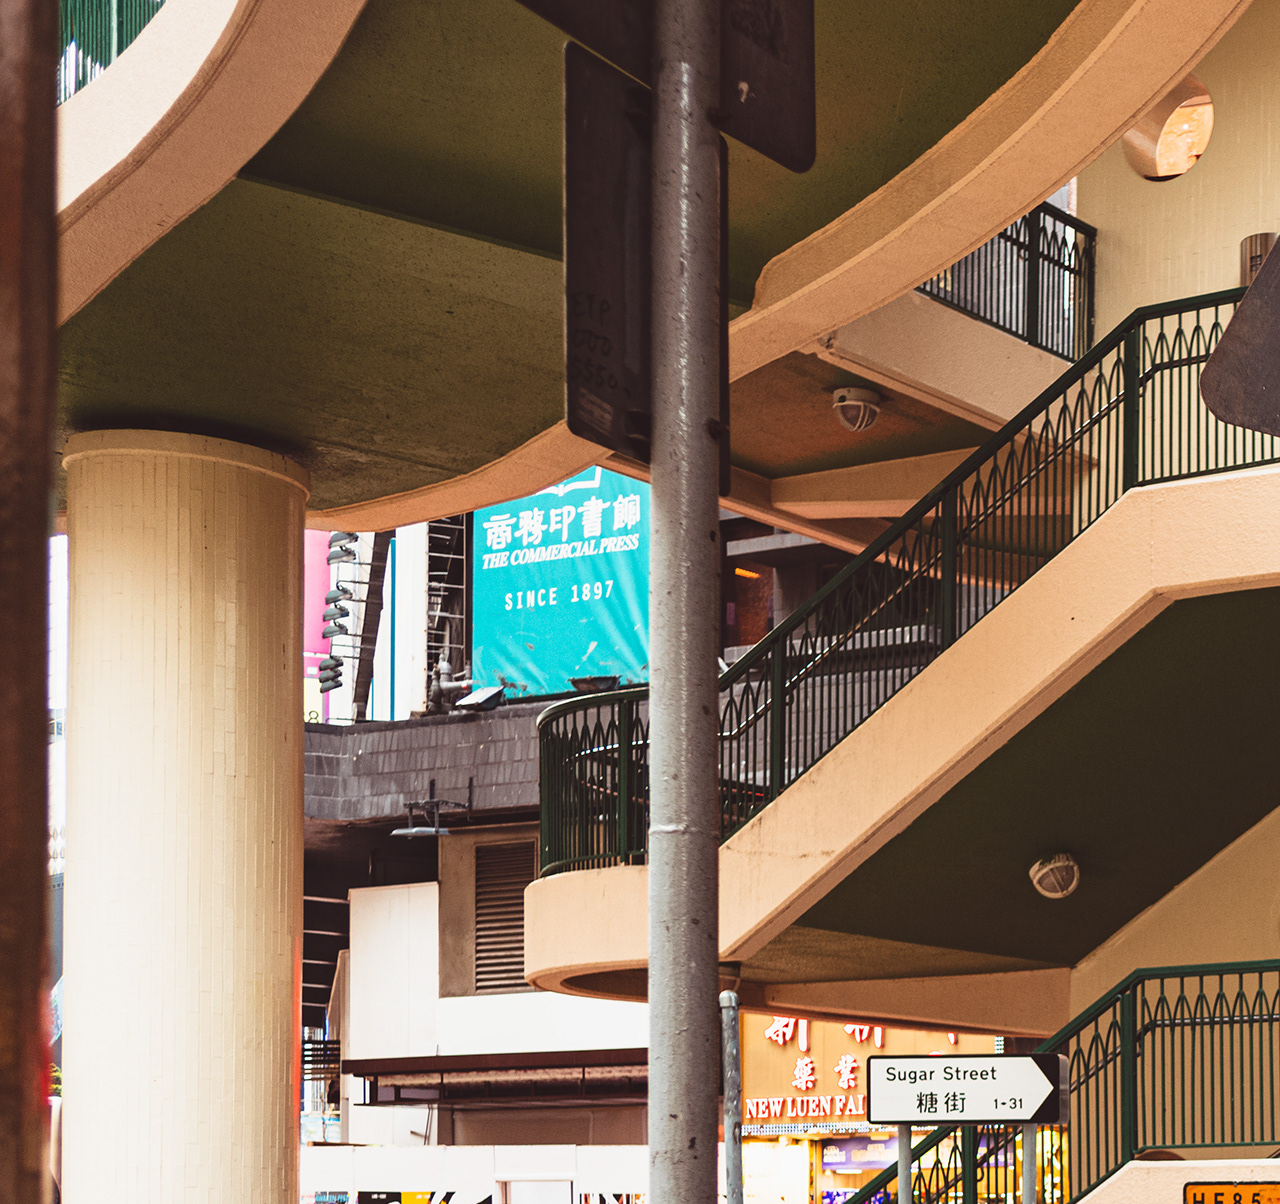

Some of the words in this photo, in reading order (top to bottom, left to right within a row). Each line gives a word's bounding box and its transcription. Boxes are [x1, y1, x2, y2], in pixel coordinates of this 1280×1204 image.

[482, 493, 641, 550] 商務印書館
[482, 551, 510, 569] THE
[510, 539, 599, 566] COMMERCIAL
[598, 533, 639, 554] PRESS
[504, 587, 558, 610] SINCE
[571, 580, 614, 602] 1897
[885, 1066, 935, 1084] Sugar
[942, 1066, 998, 1082] Street
[745, 1096, 785, 1119] NEW
[786, 1095, 833, 1118] LUEN
[834, 1093, 865, 1116] FAI
[916, 1090, 967, 1114] 糖街
[992, 1097, 1024, 1111] 1-31
